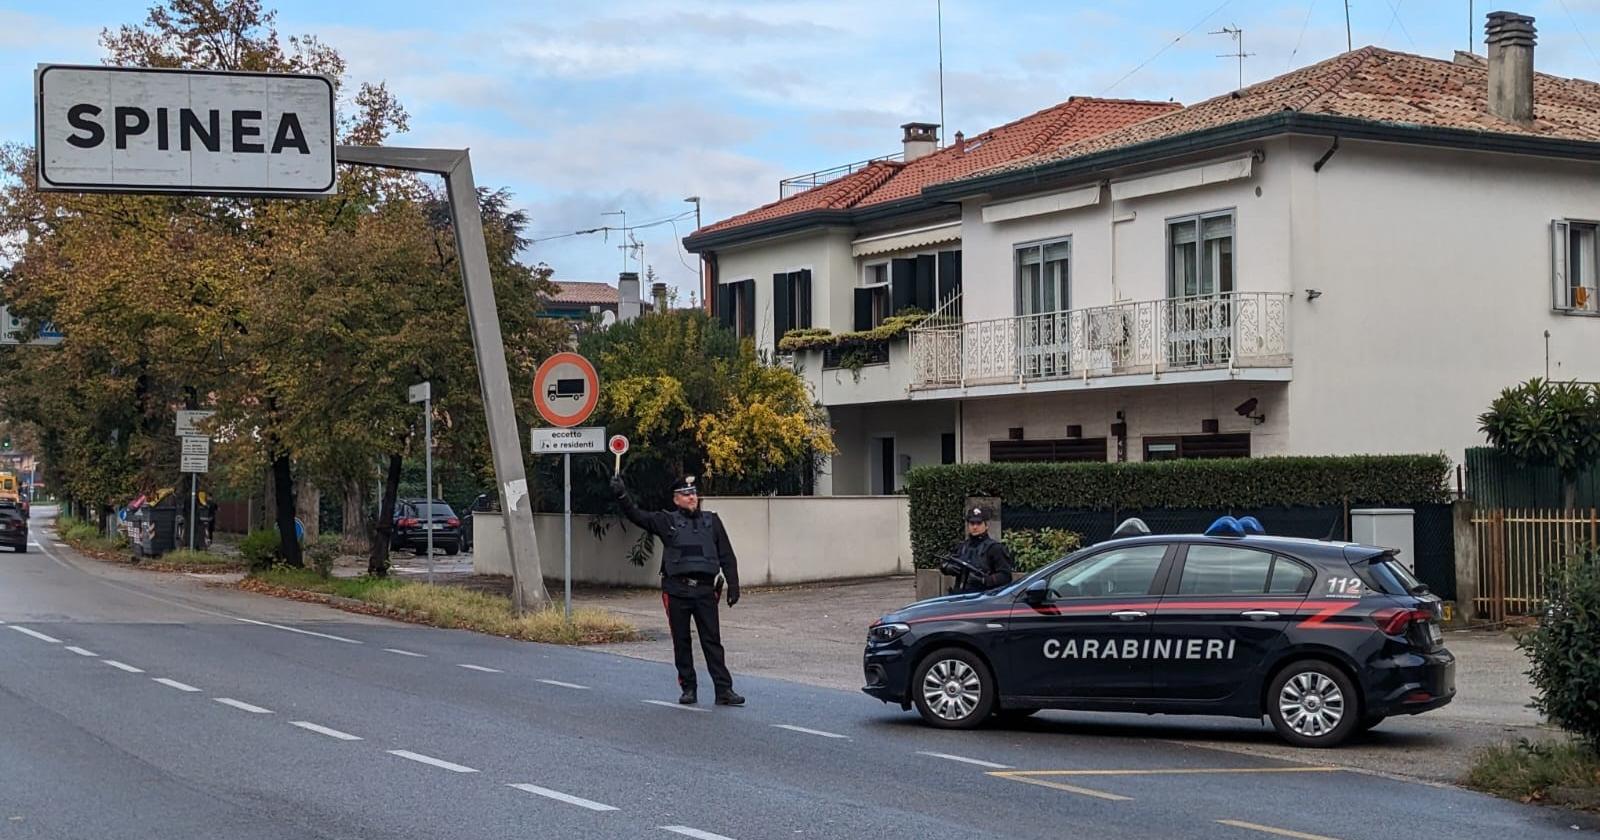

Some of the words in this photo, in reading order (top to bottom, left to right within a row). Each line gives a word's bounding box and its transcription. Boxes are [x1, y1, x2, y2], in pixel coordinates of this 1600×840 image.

[66, 103, 311, 155] SPINEA
[1327, 577, 1362, 594] 112
[1043, 639, 1236, 659] CARABINIERI
